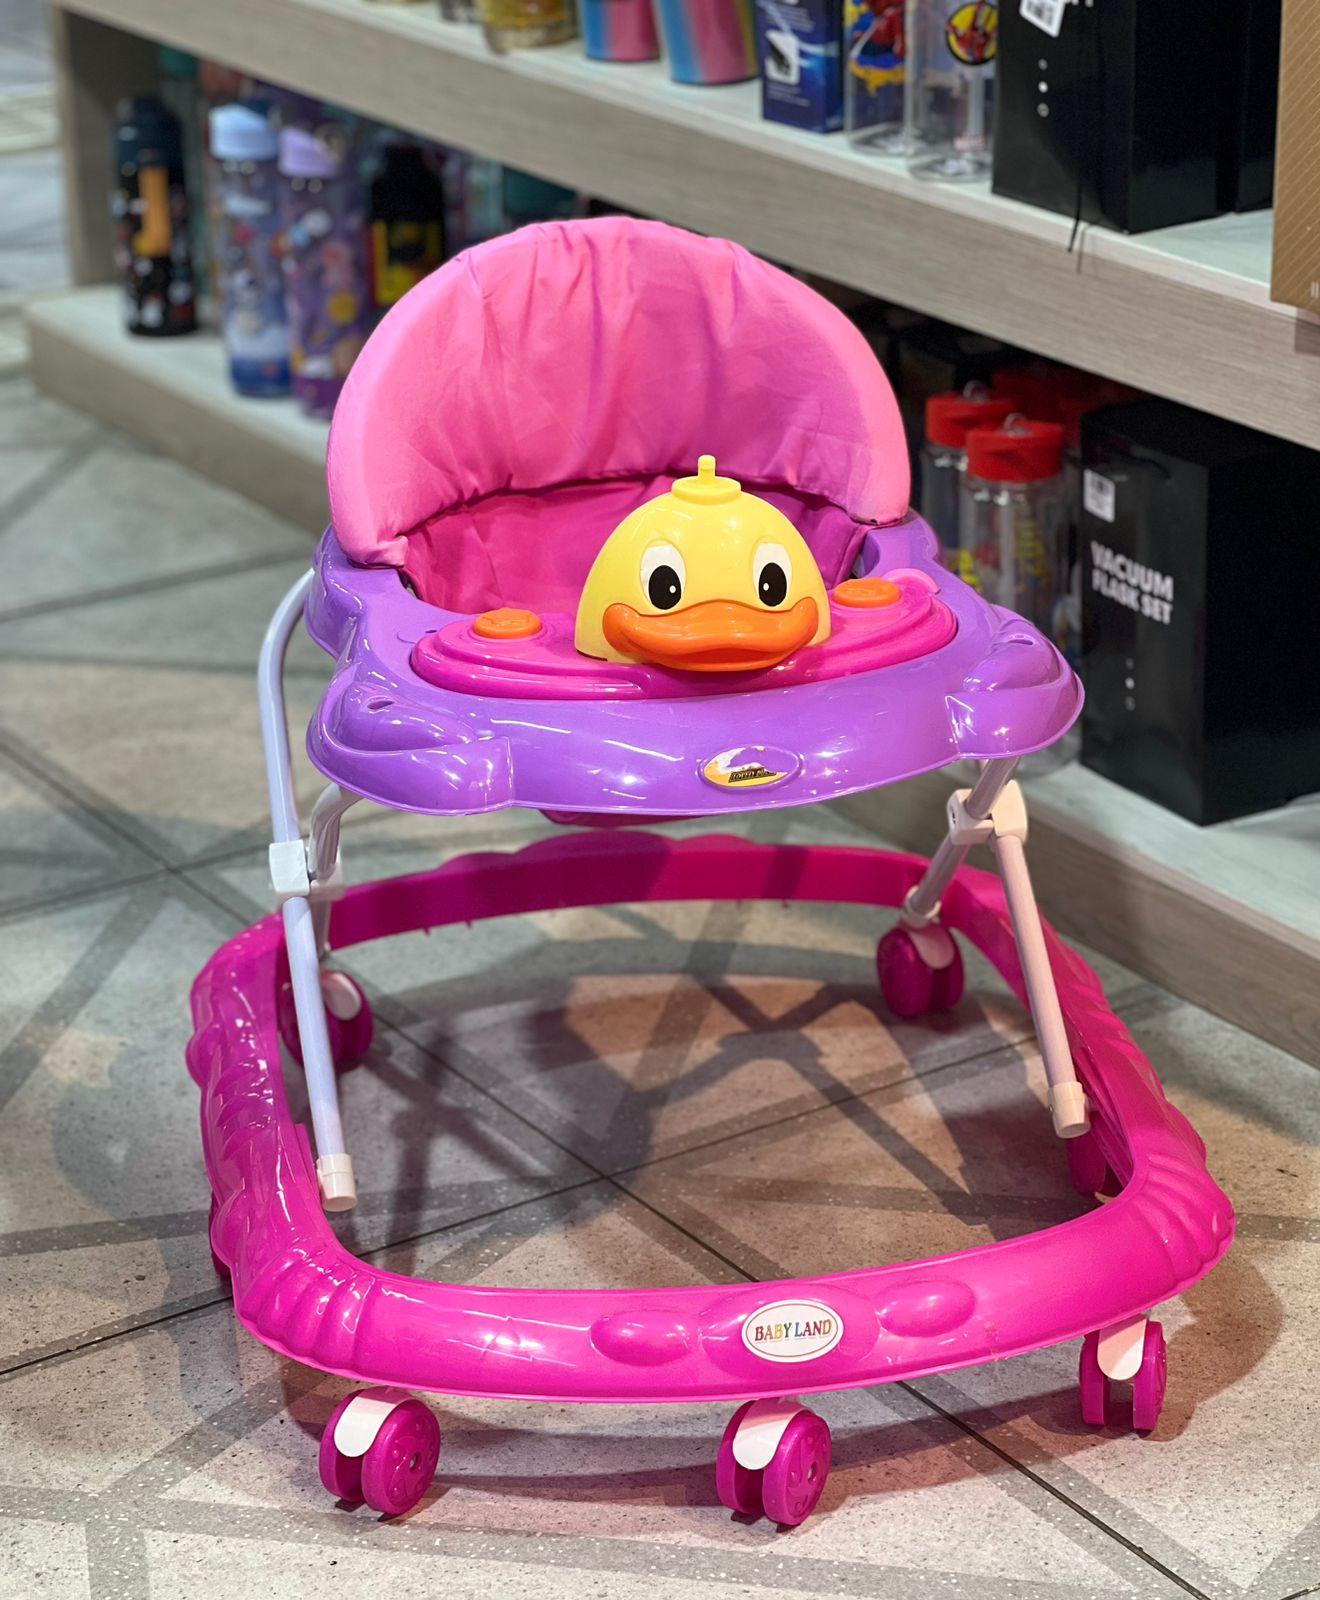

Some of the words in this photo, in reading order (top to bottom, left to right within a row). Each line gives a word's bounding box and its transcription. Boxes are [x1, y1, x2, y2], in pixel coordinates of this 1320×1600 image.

[1091, 541, 1173, 602] VACUUM
[1092, 568, 1140, 612] FLASK
[1141, 593, 1173, 625] SET
[755, 1322, 792, 1341] BABY
[794, 1319, 832, 1338] LAND
